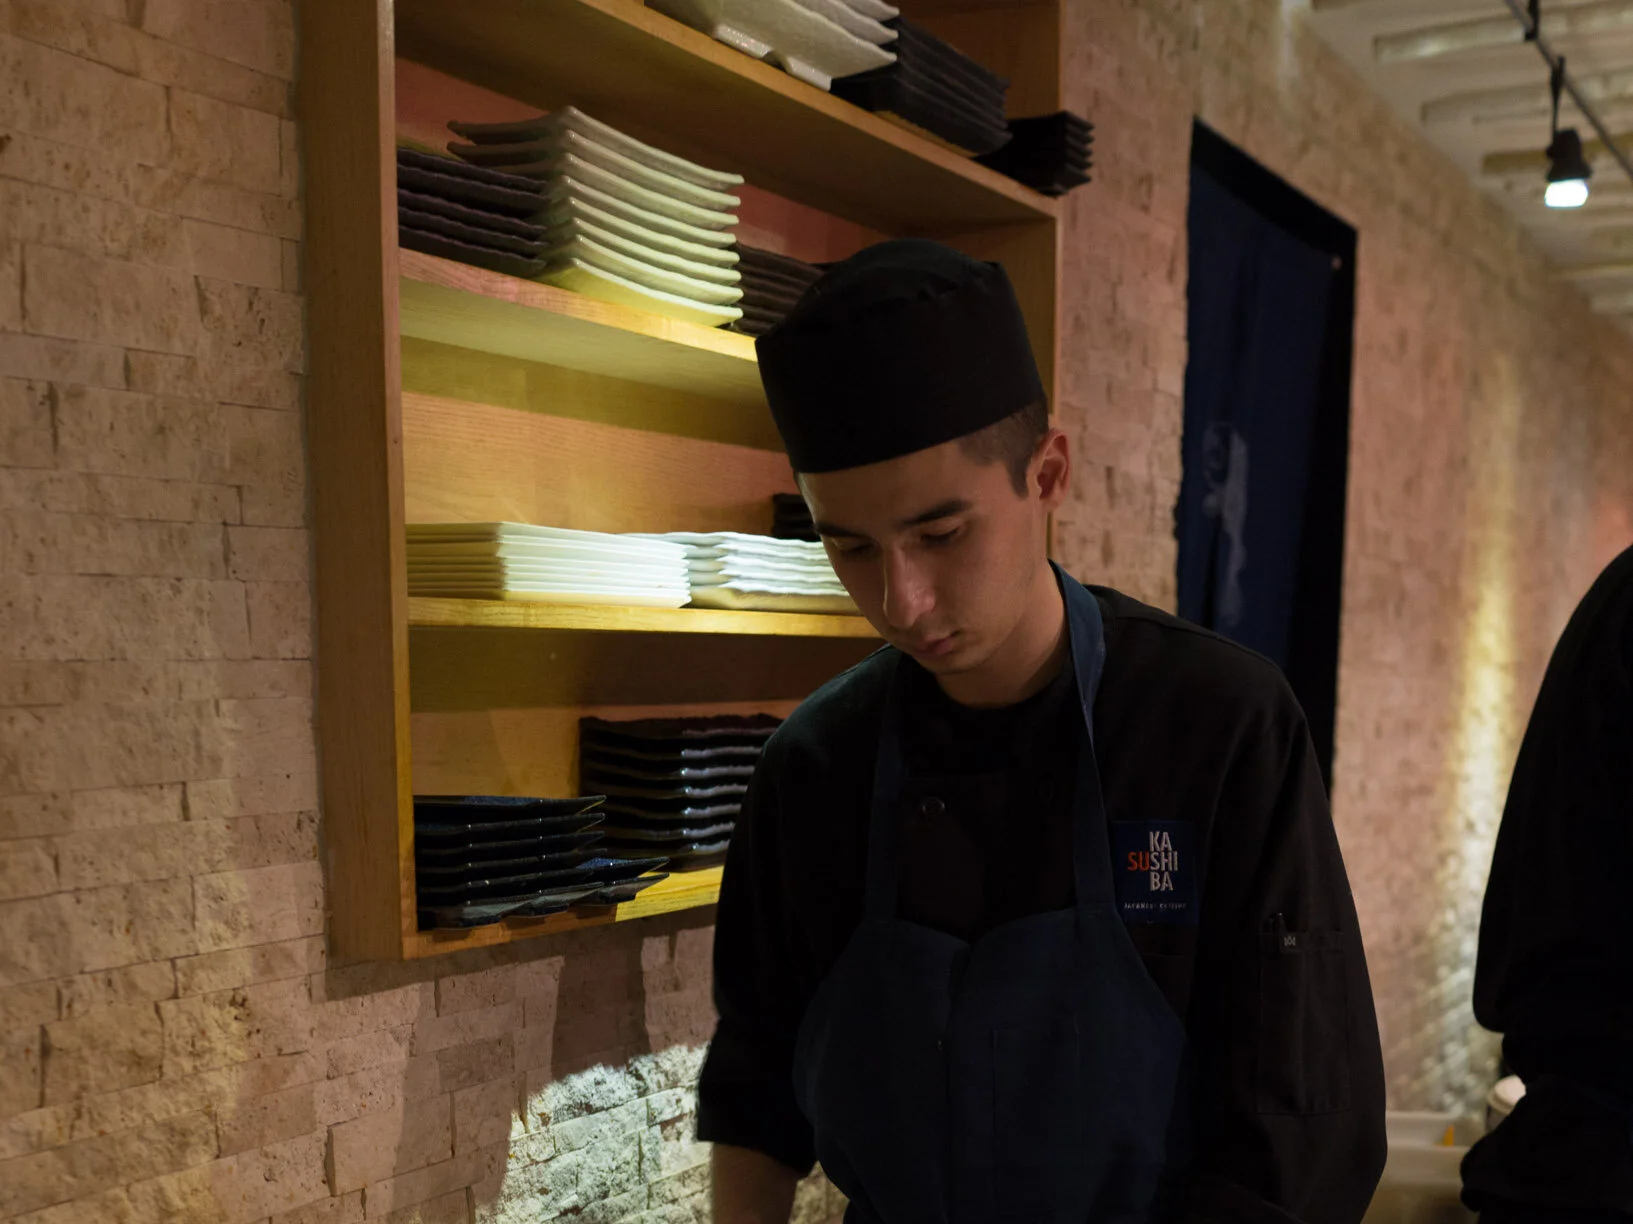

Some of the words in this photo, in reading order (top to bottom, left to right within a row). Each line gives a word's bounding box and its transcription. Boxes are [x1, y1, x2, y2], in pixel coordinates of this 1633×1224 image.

[1149, 831, 1173, 852] KA
[1127, 851, 1178, 872] SUSHI
[1149, 871, 1174, 891] BA
